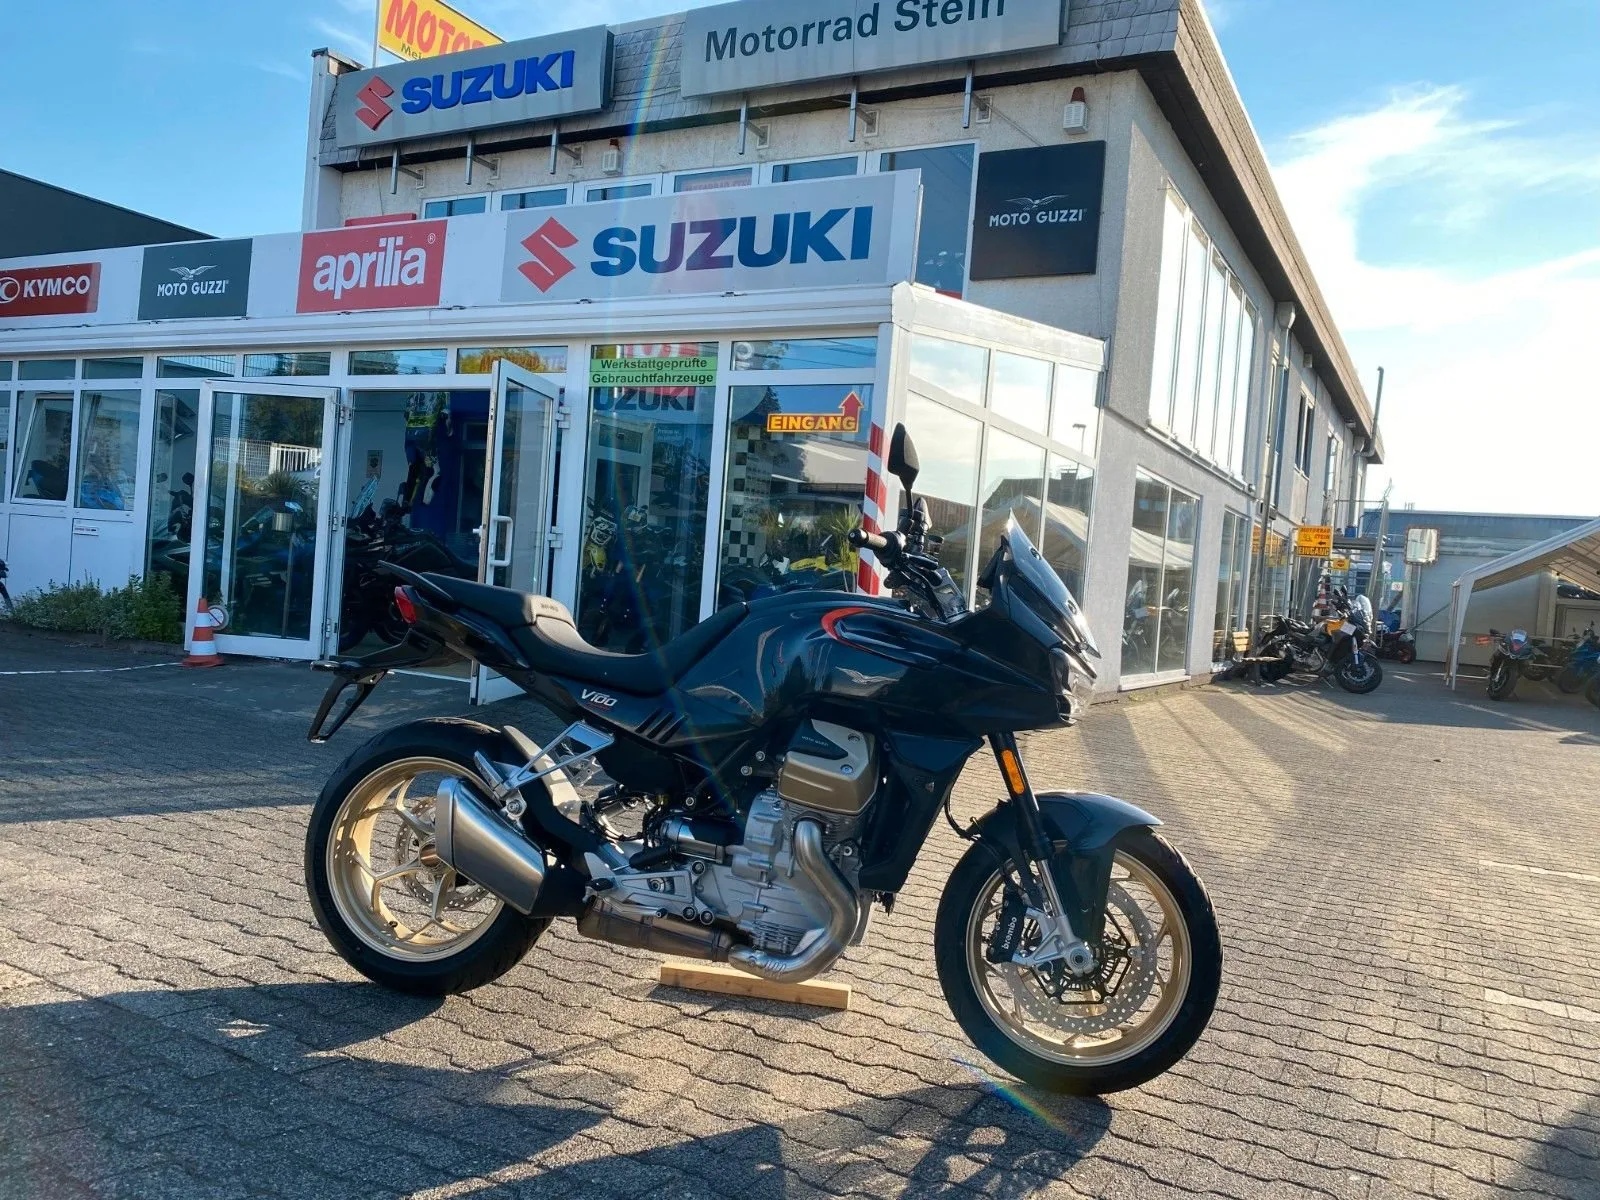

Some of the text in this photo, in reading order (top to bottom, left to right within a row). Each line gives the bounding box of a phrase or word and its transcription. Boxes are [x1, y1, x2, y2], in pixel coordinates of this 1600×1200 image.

[705, 2, 880, 62] Motorrad
[401, 50, 575, 114] SUZUKI
[989, 208, 1083, 227] MOTO GUZZI
[591, 206, 873, 277] SUZUKI
[313, 236, 426, 299] aprilia
[23, 275, 91, 298] KYMCO
[157, 280, 226, 296] MOTO GUZZI
[601, 358, 707, 371] Werkstattgeprüfte
[592, 372, 714, 384] Gebrauchtfahrzeuge
[770, 416, 856, 430] EINGANG
[1298, 547, 1329, 556] EINGANG
[581, 689, 618, 706] V100
[1002, 917, 1017, 949] brembo
